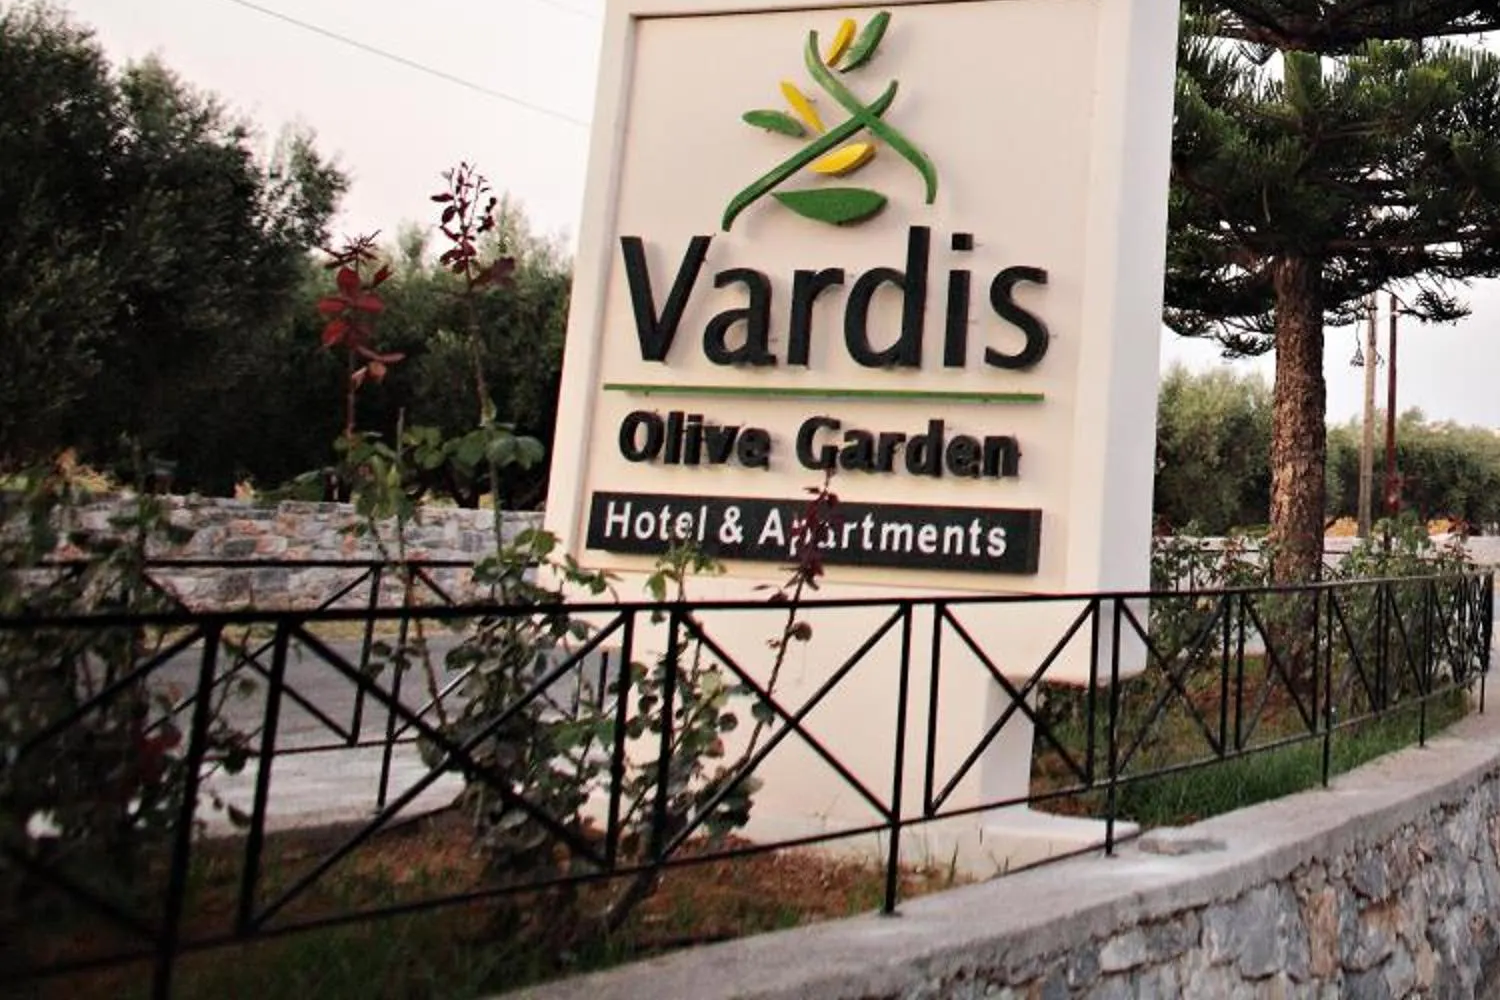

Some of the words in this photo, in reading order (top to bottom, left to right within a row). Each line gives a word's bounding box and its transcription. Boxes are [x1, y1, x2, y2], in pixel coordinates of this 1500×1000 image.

[620, 226, 1050, 370] Vardis
[618, 410, 771, 469] Olive
[796, 415, 1020, 478] Garden
[604, 501, 708, 541] Hotel
[719, 505, 744, 544] &
